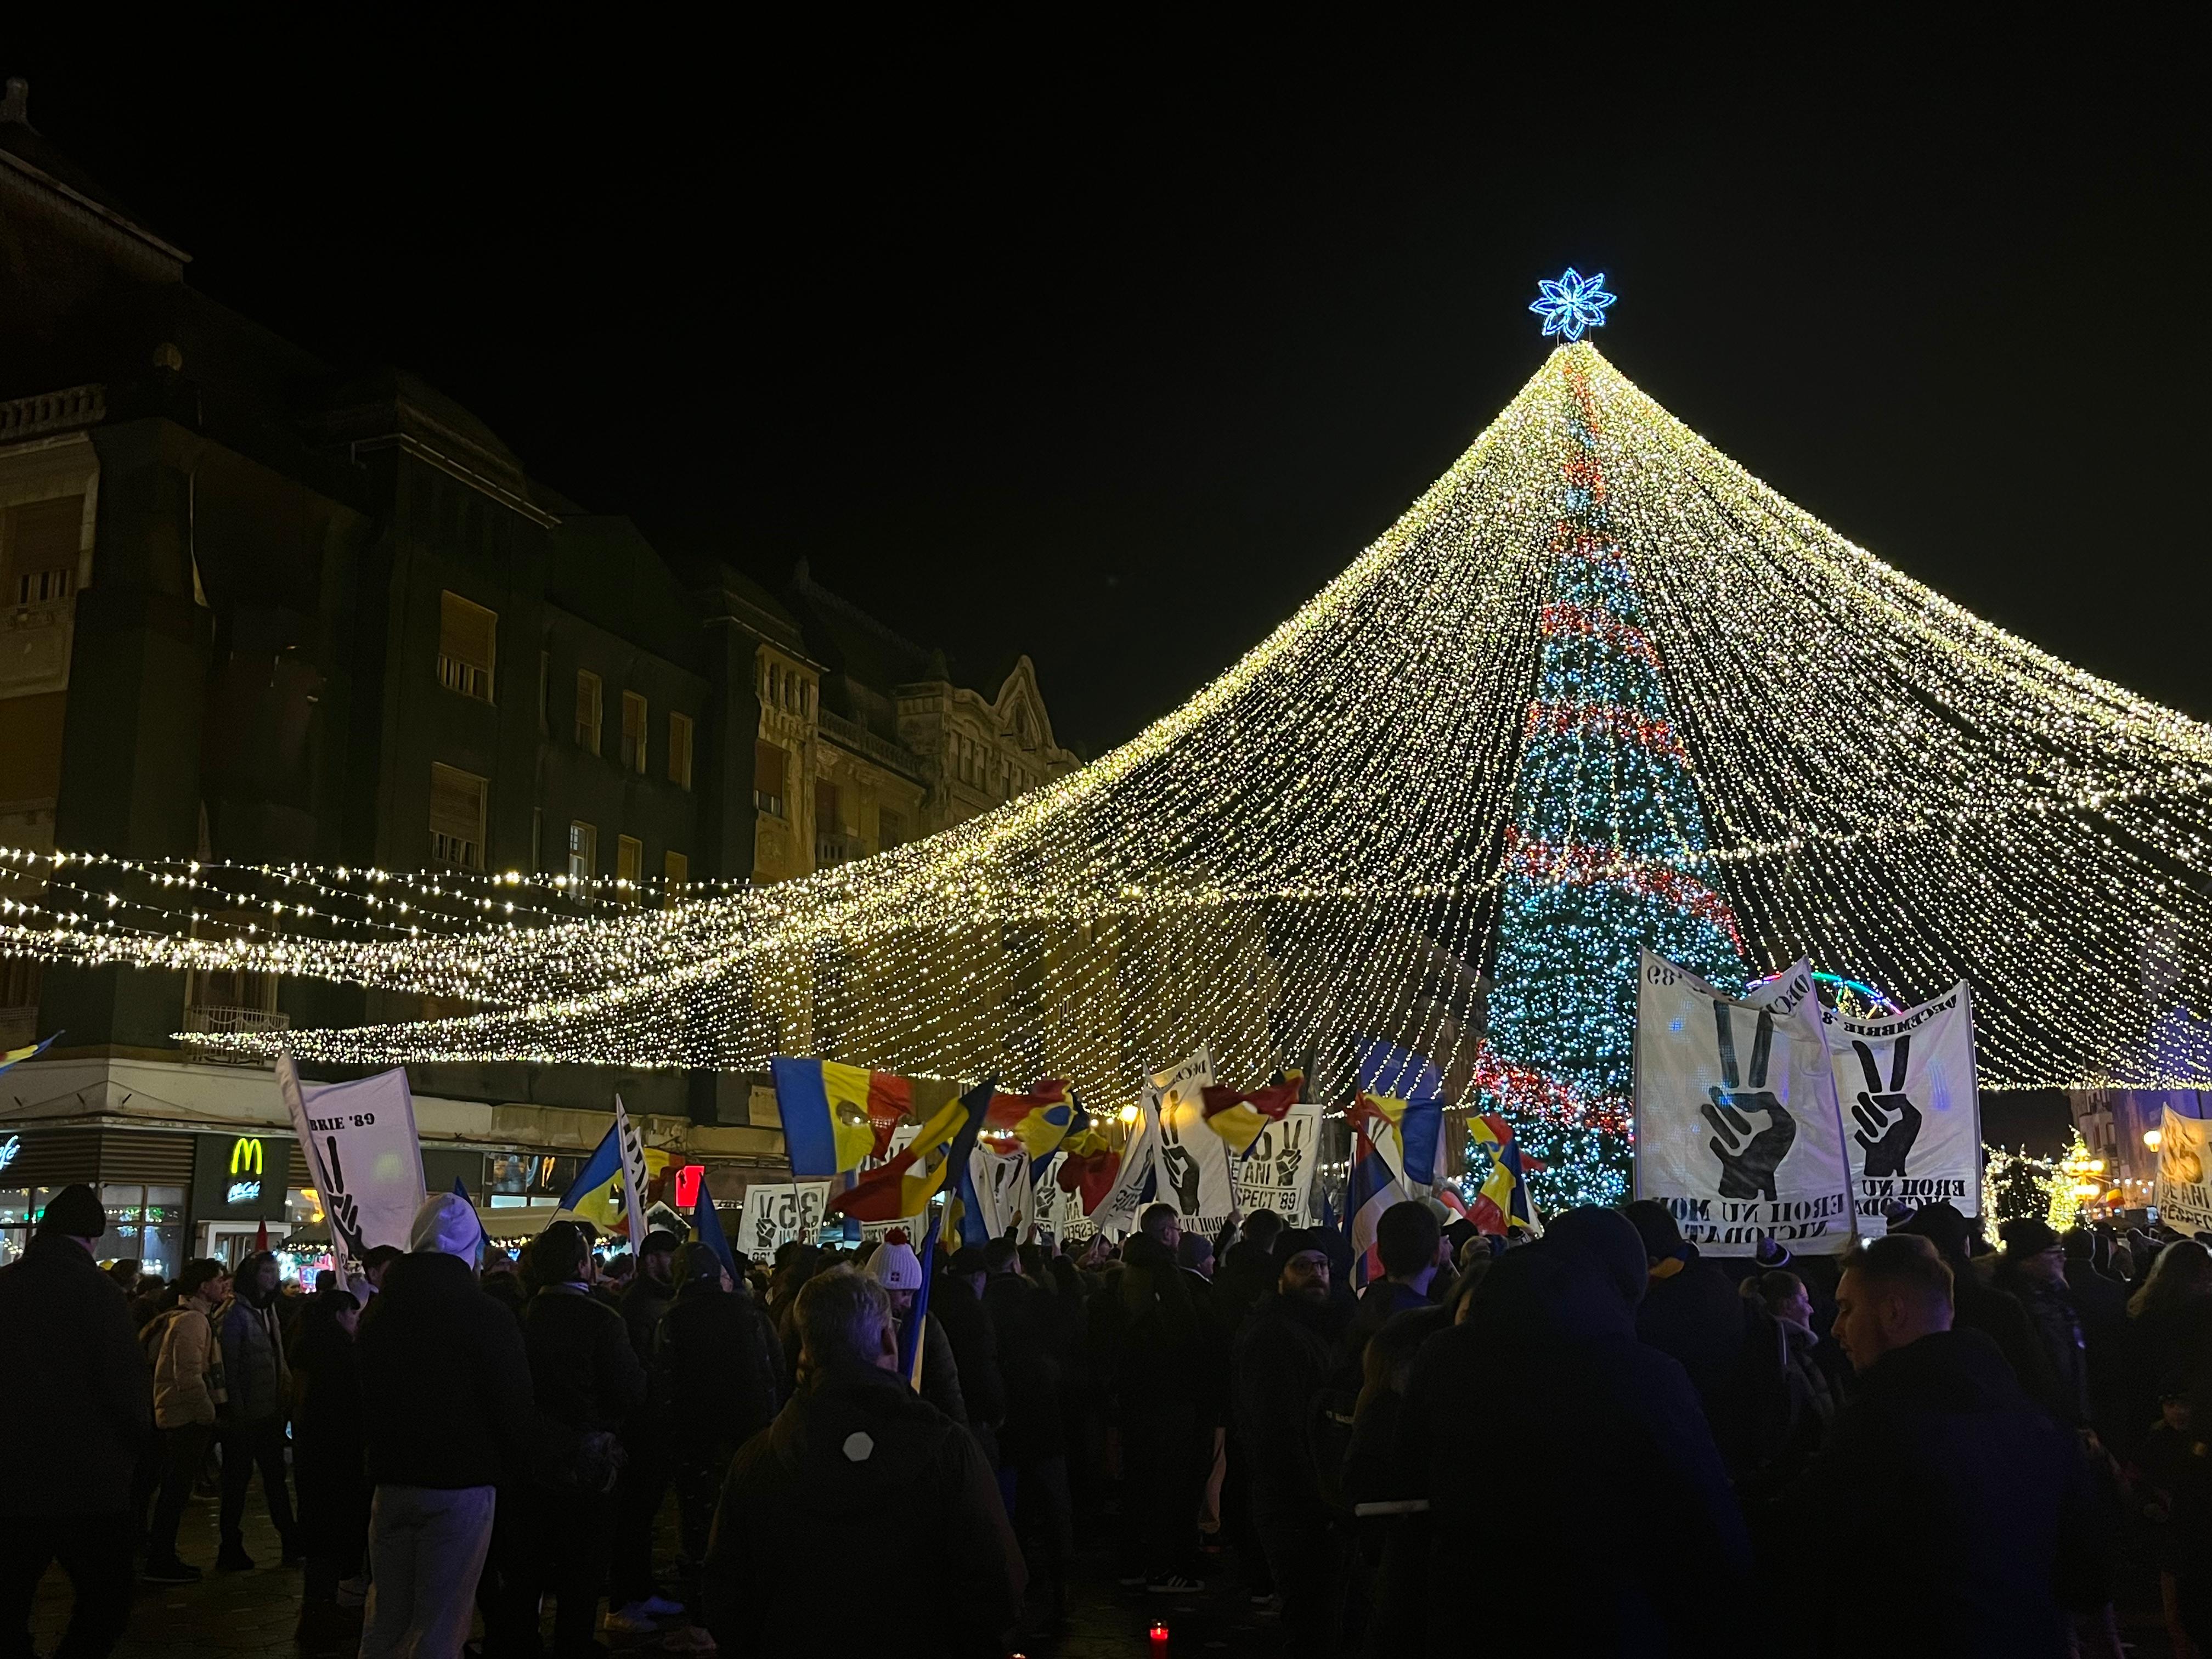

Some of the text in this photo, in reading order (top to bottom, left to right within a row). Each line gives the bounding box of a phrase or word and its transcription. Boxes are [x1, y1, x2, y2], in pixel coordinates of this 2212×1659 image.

[349, 1113, 375, 1126] '89
[1244, 1161, 1271, 1185] ANI
[1278, 1192, 1296, 1210] '89
